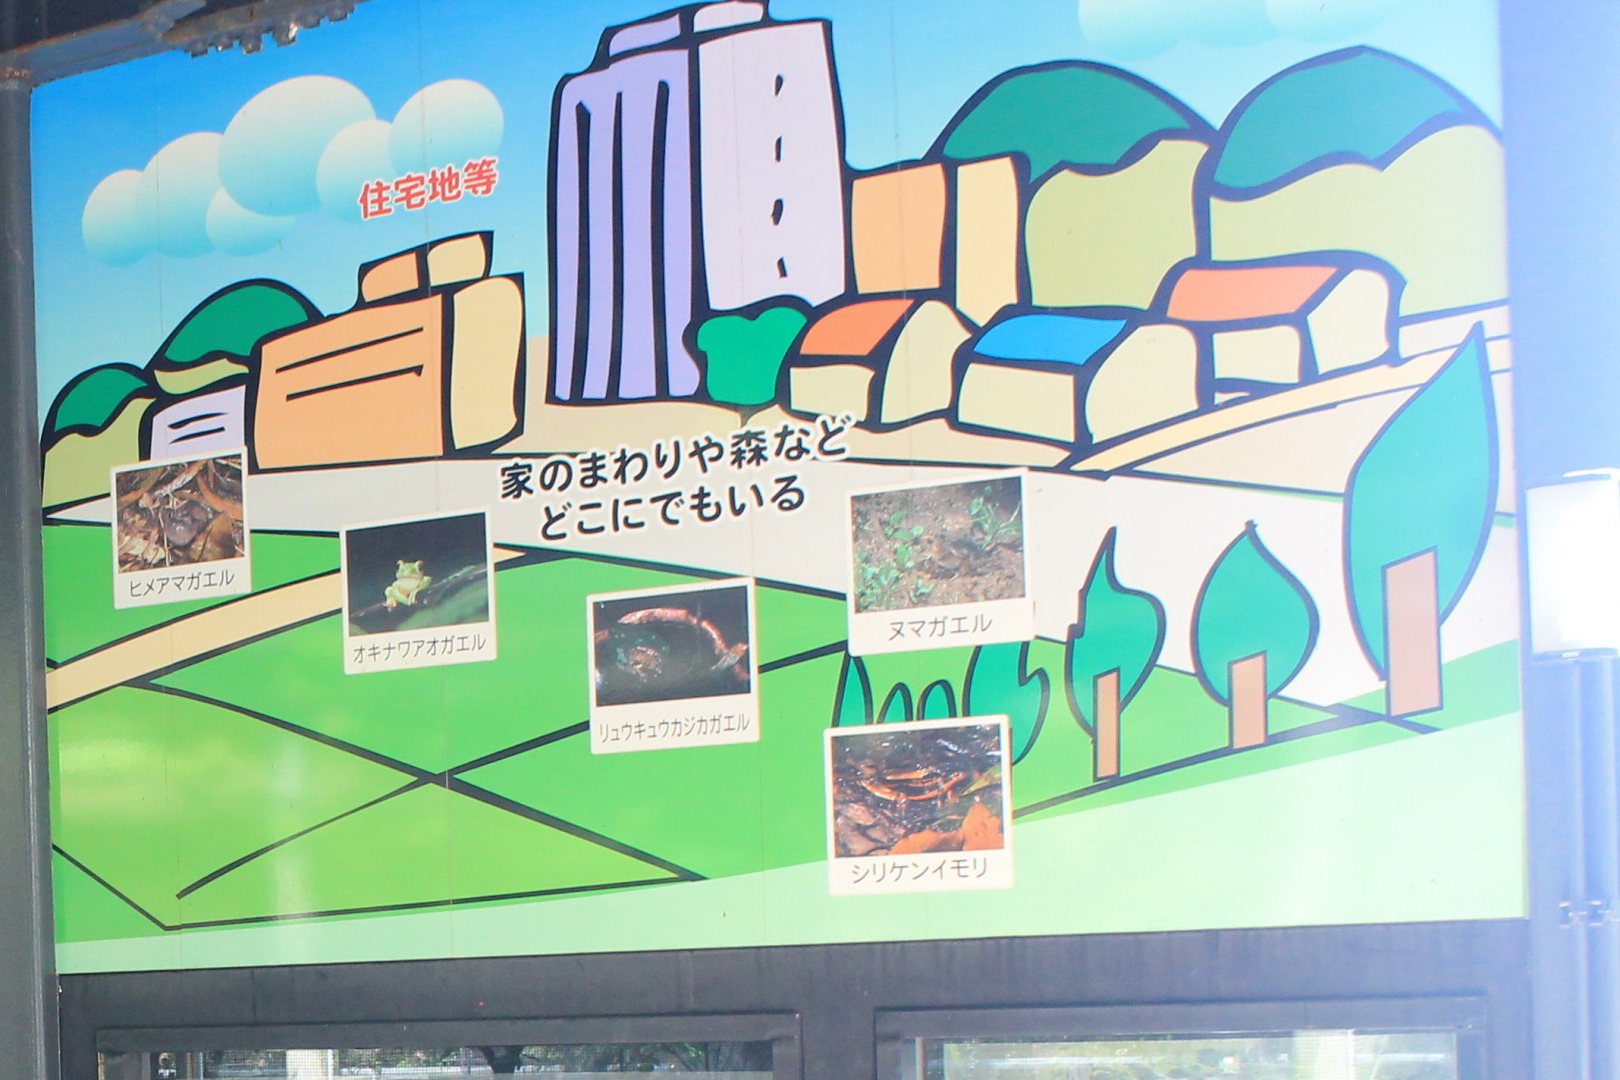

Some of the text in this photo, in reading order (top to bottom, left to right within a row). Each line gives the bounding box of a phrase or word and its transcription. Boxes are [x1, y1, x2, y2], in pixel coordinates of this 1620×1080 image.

[358, 157, 499, 221] 住宅地等
[500, 414, 854, 500] 家のまわりや森など
[540, 474, 806, 541] どこにでもいる
[129, 569, 235, 598] ヒメアマガエル
[888, 613, 994, 642] ヌマガエル
[352, 633, 487, 665] オキナワアオガエル
[599, 713, 751, 744] リュウキュウカジカガエル
[851, 857, 988, 885] シリケンイモリ
